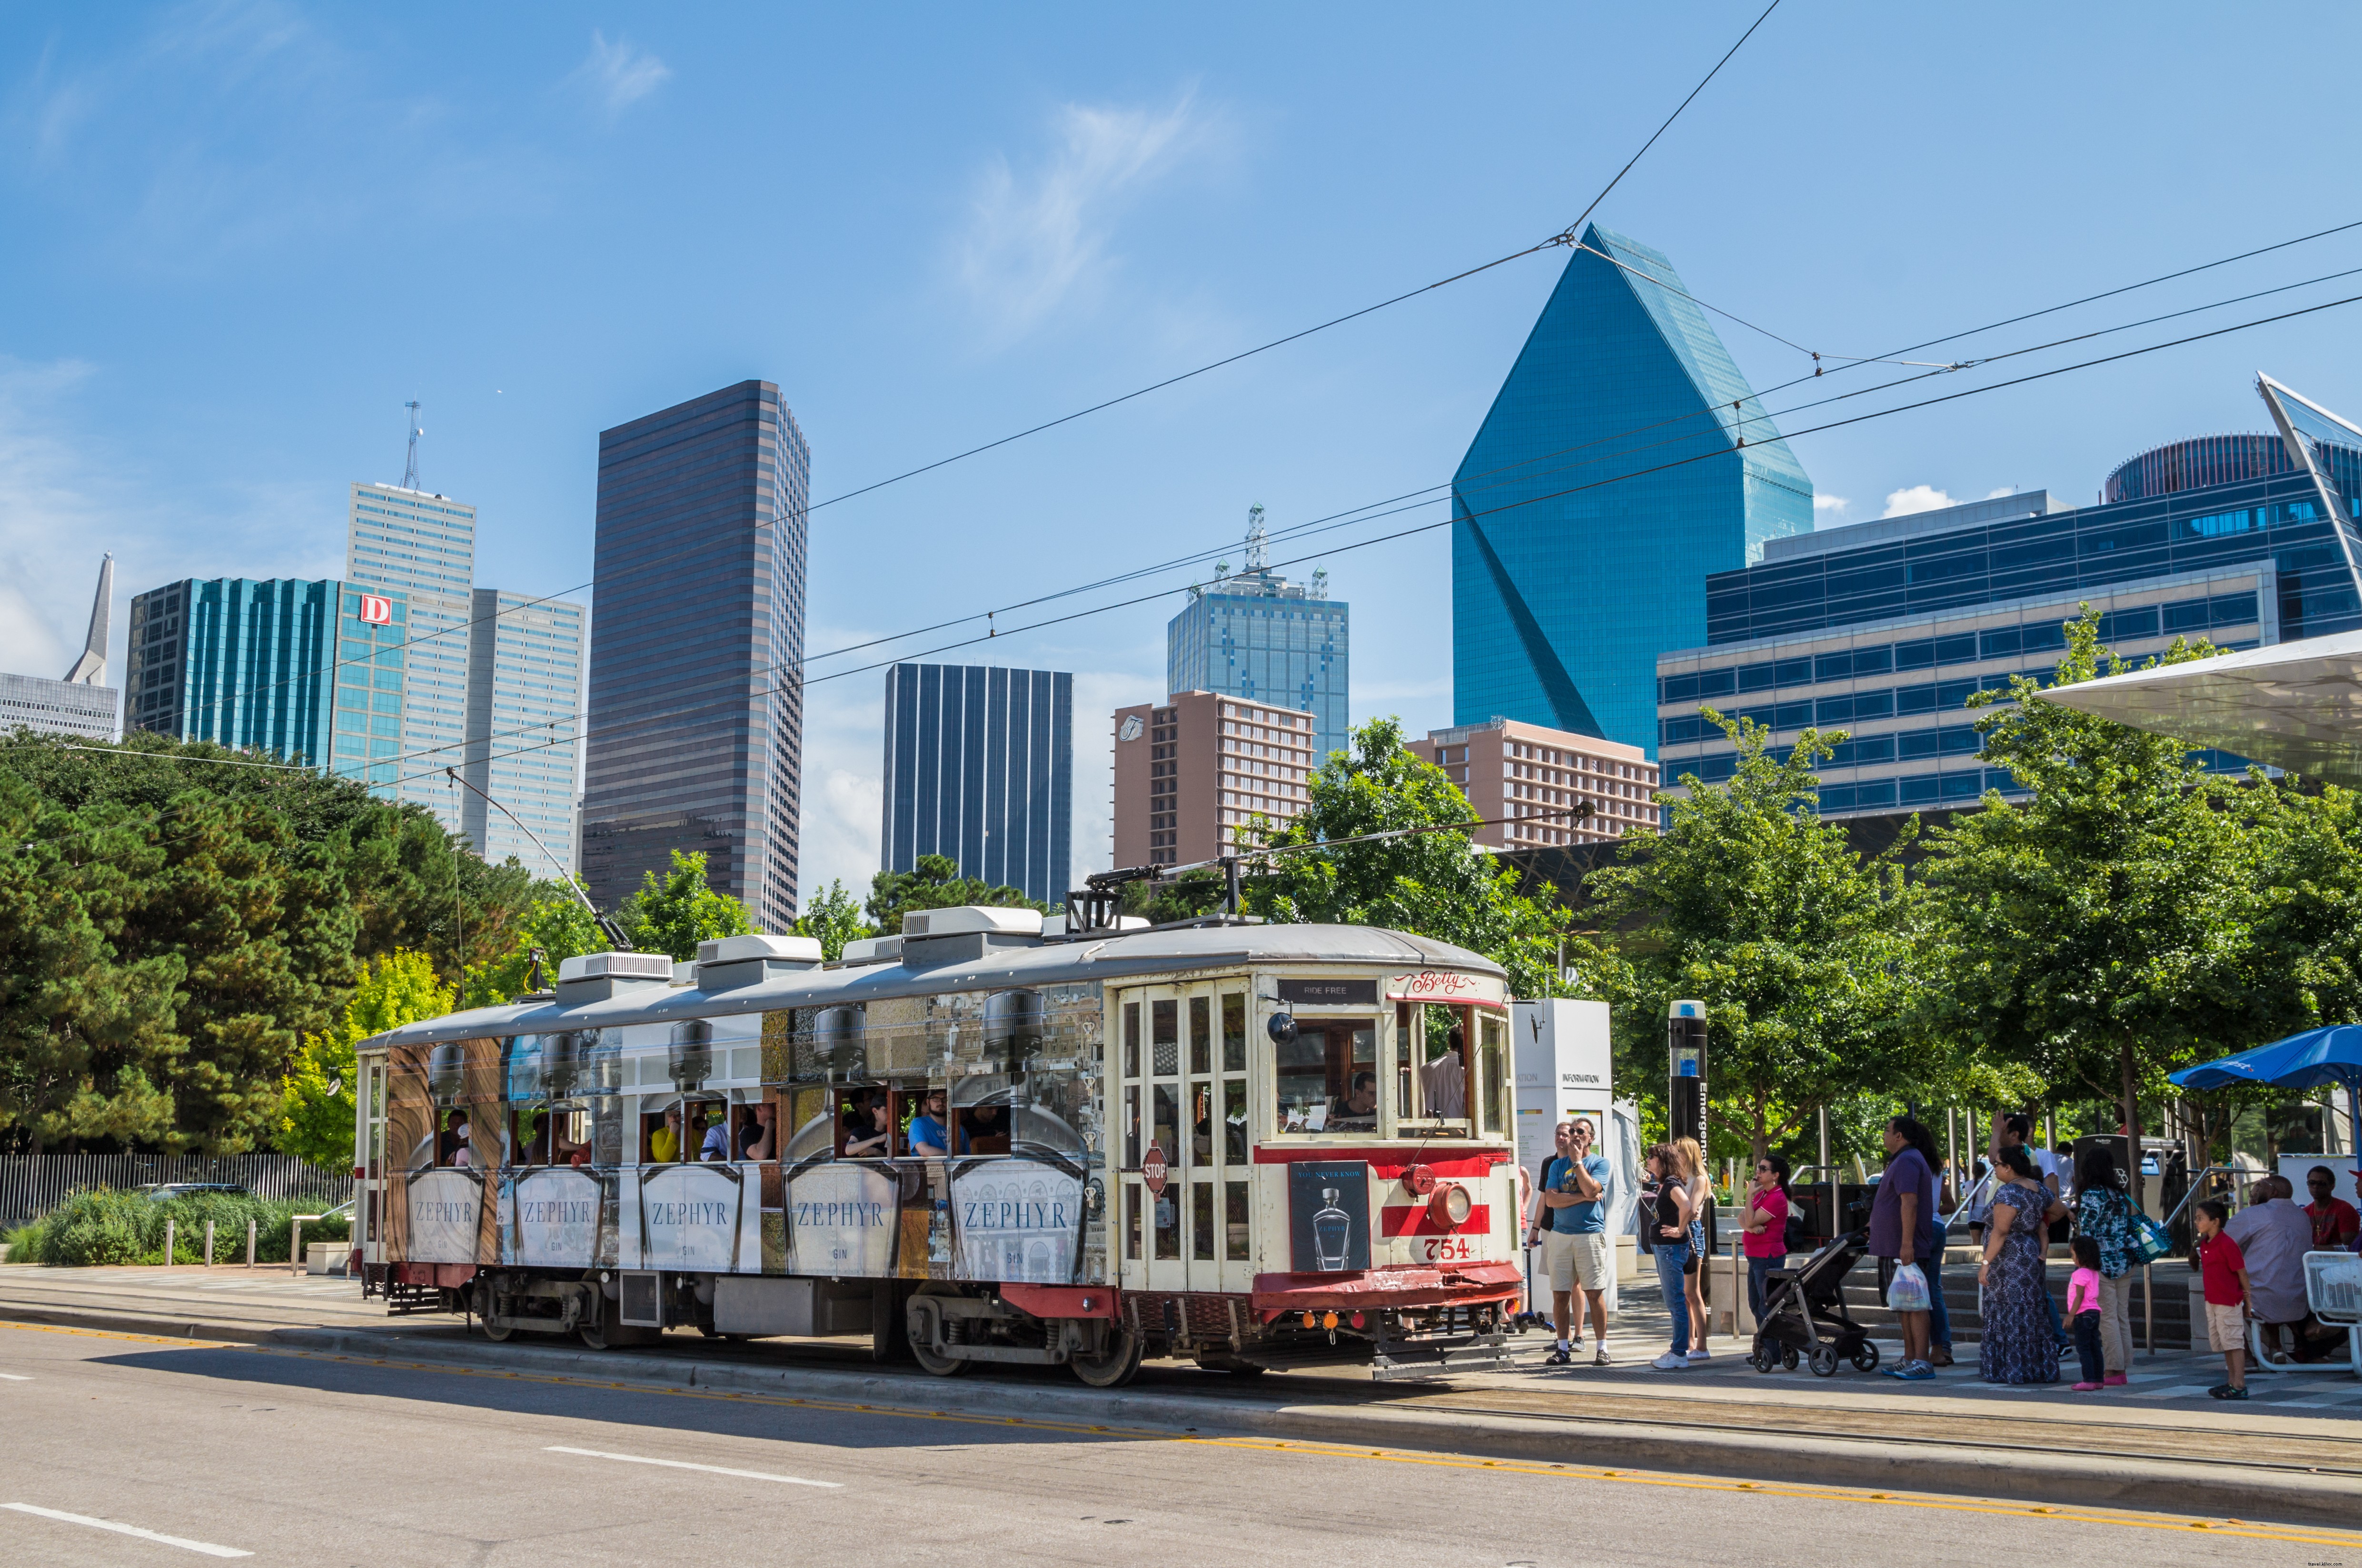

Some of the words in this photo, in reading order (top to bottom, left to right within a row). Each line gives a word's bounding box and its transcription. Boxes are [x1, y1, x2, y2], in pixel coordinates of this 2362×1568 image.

[364, 596, 389, 622] D
[1412, 970, 1466, 994] Betty
[1562, 1073, 1599, 1083] INFORMATION
[1698, 1082, 1707, 1166] Emergency
[1145, 1163, 1166, 1179] STOP
[416, 1201, 472, 1222] ZEPHYR
[525, 1201, 590, 1223] ZEPHYR
[653, 1202, 727, 1225] ZEPHYR
[798, 1202, 883, 1227] ZEPHYR
[965, 1202, 1067, 1228] ZEPHYR
[437, 1240, 447, 1249] GIN
[551, 1241, 562, 1251] GIN
[682, 1246, 695, 1256] GIN
[833, 1249, 847, 1260] GIN
[1424, 1238, 1470, 1260] 754
[1007, 1253, 1023, 1264] GIN
